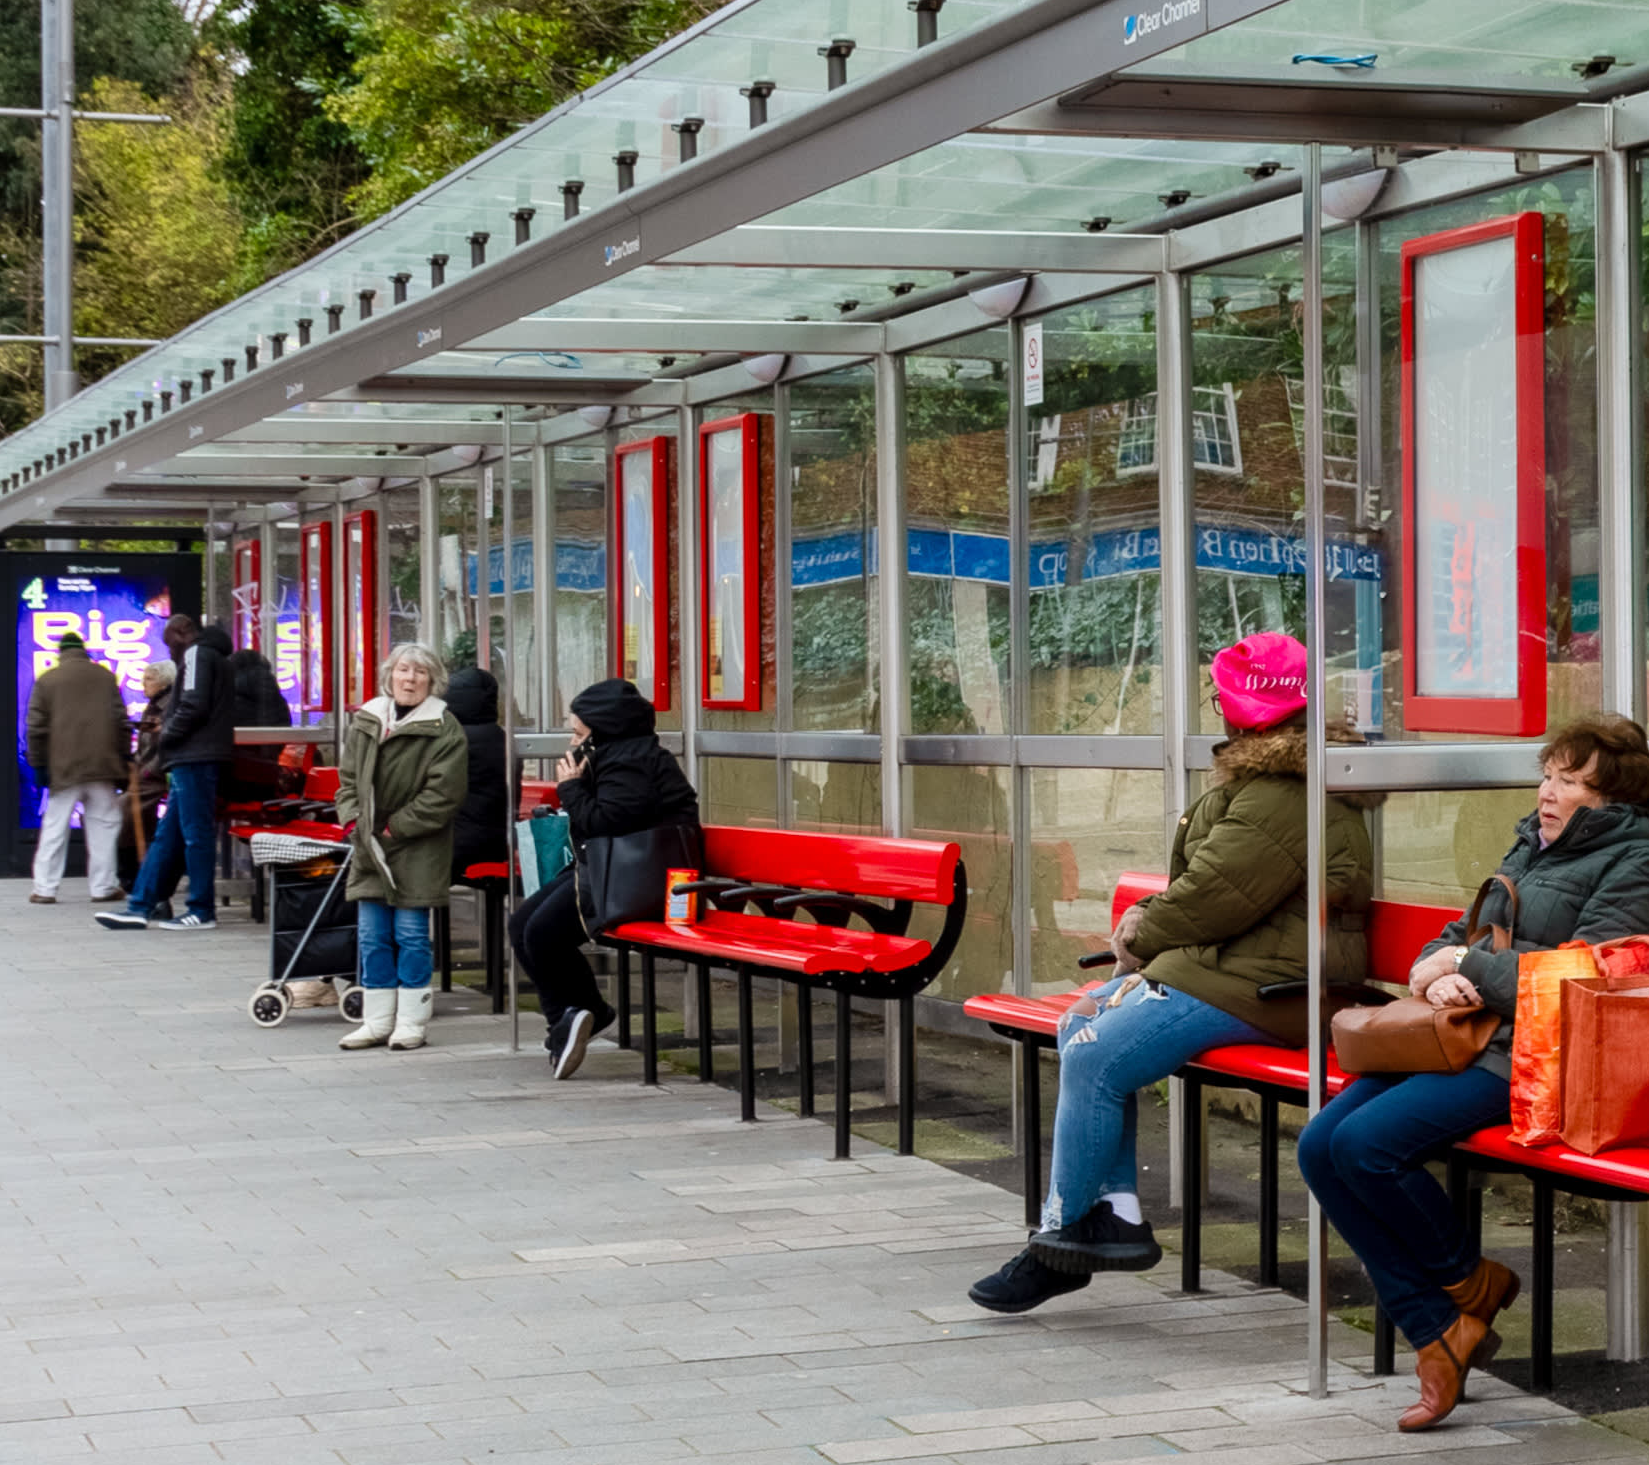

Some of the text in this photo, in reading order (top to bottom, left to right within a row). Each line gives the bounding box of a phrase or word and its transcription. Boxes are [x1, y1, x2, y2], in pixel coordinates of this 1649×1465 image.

[1137, 12, 1161, 36] Clear
[21, 577, 48, 609] 4
[33, 609, 151, 661] Big
